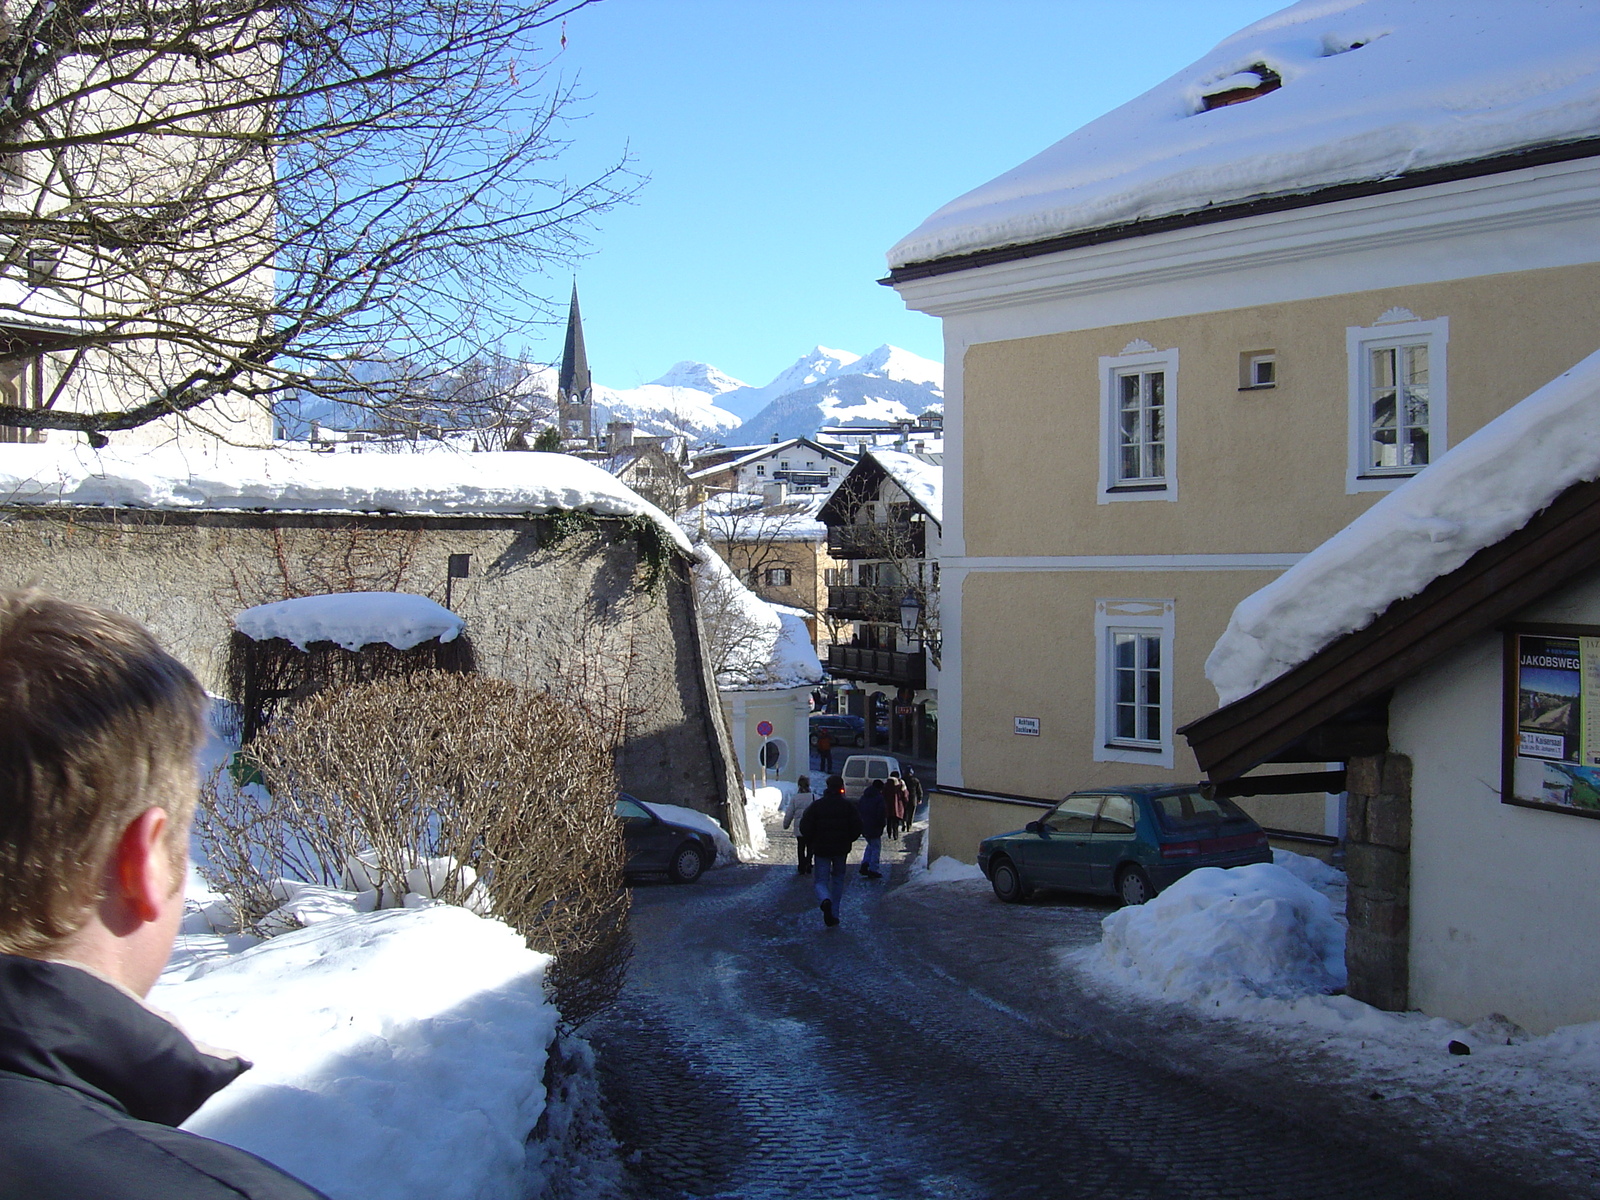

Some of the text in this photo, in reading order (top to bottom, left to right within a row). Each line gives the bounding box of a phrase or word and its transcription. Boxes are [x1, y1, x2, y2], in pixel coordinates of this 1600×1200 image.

[1520, 655, 1580, 669] JAKOBSWEG
[1019, 719, 1035, 727] Achtung
[1015, 726, 1038, 734] Dachlawine
